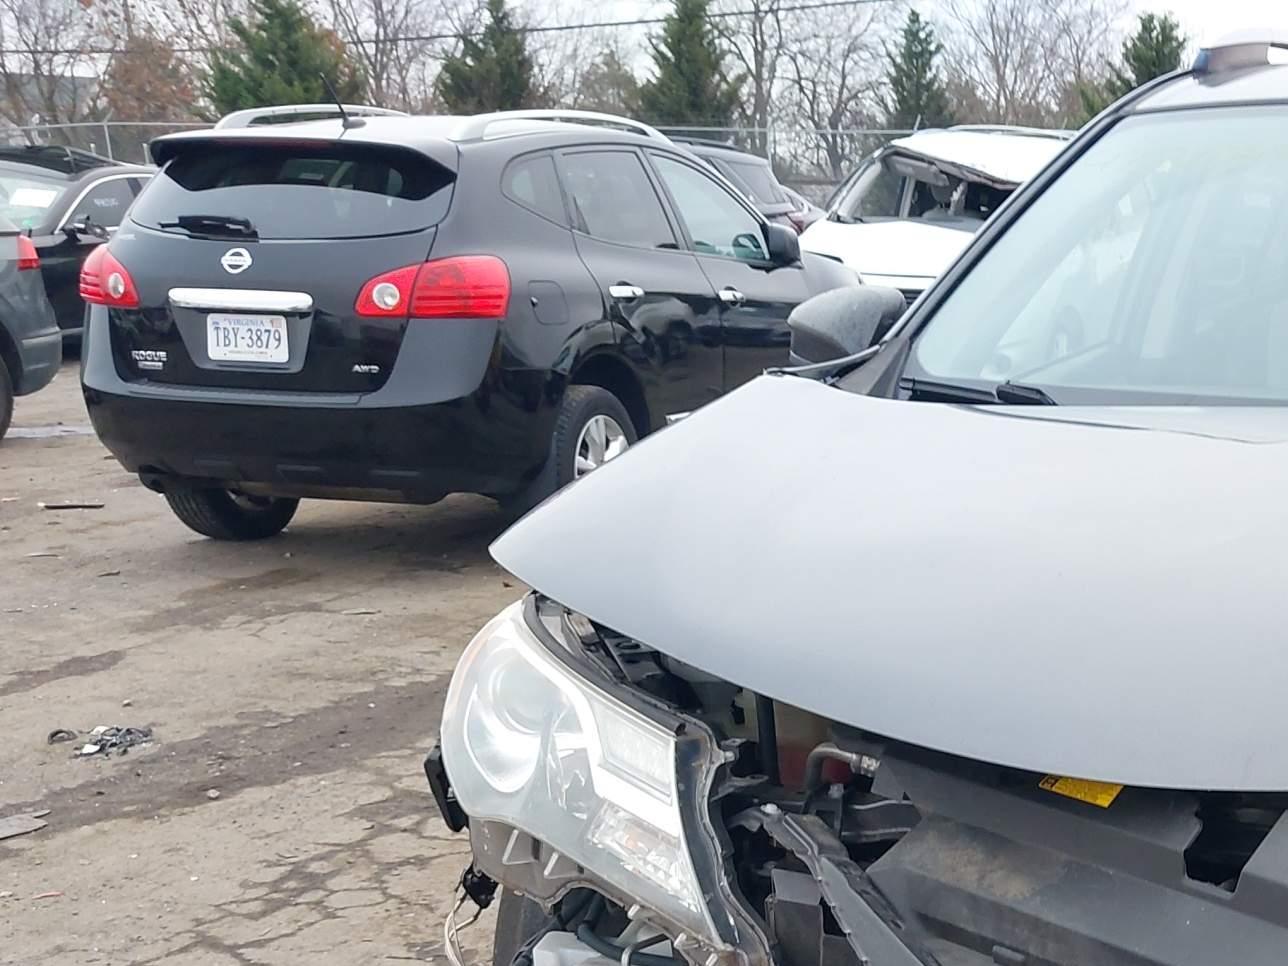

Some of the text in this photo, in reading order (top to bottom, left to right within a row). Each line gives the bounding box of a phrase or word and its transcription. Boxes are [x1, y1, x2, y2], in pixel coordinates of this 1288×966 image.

[228, 319, 265, 327] VIRGINIA
[214, 326, 281, 350] TBY-3879
[131, 350, 168, 361] ROGUE
[352, 364, 380, 374] AWD
